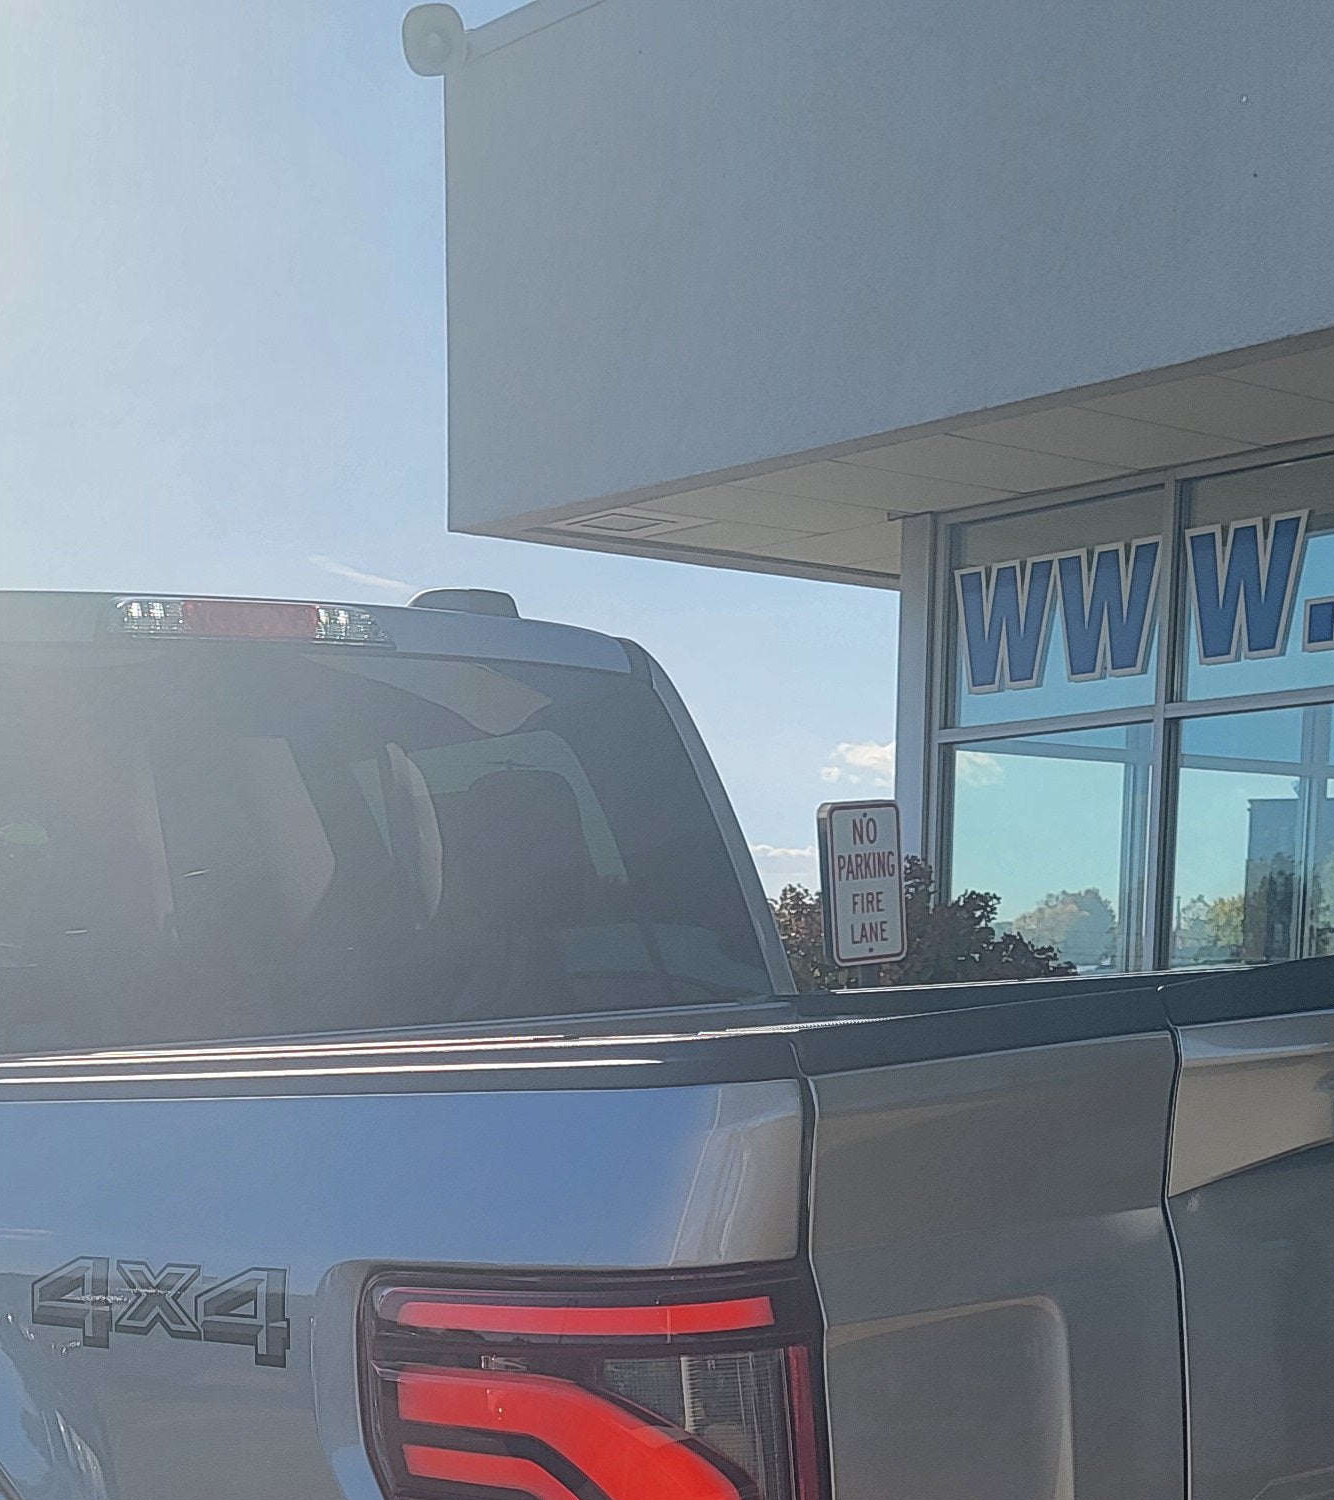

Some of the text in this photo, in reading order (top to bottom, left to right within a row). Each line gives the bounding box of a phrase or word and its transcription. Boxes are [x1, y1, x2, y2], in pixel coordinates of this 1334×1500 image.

[852, 818, 877, 845] NO
[838, 851, 895, 882] PARKING
[852, 892, 885, 914] FIRE
[851, 921, 889, 944] LANE
[31, 1255, 291, 1369] 4X4
